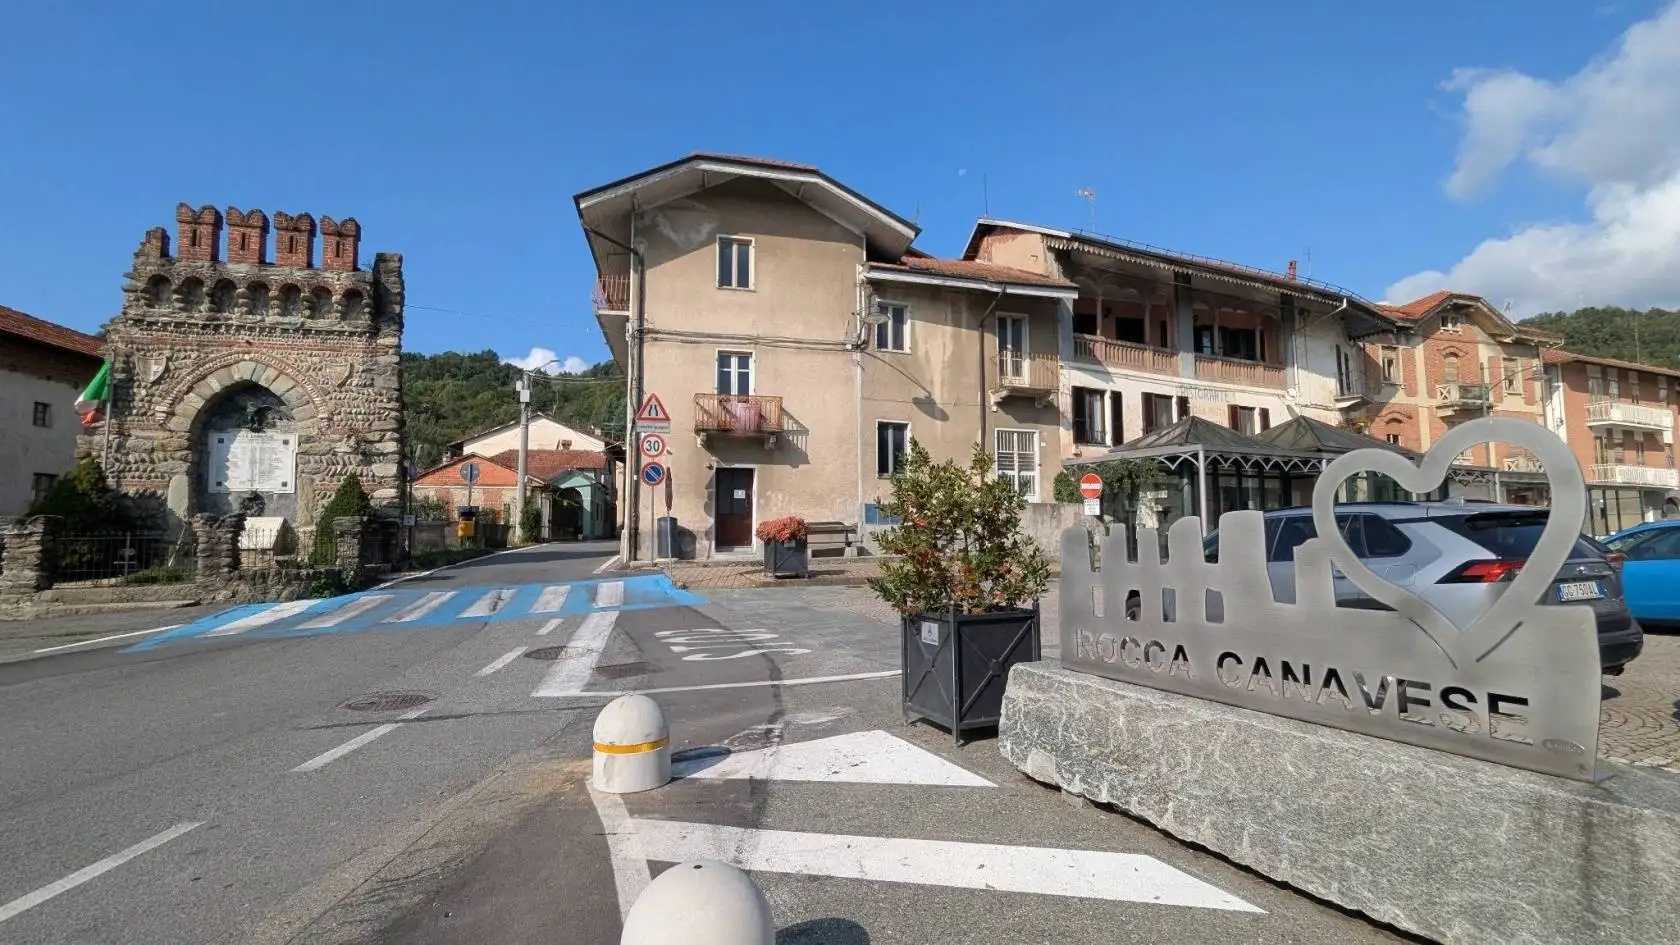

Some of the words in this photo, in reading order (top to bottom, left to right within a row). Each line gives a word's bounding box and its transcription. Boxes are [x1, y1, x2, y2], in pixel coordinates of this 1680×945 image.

[645, 440, 660, 452] 30
[1075, 629, 1197, 681] ROCCA
[1217, 651, 1534, 746] CANAVESE
